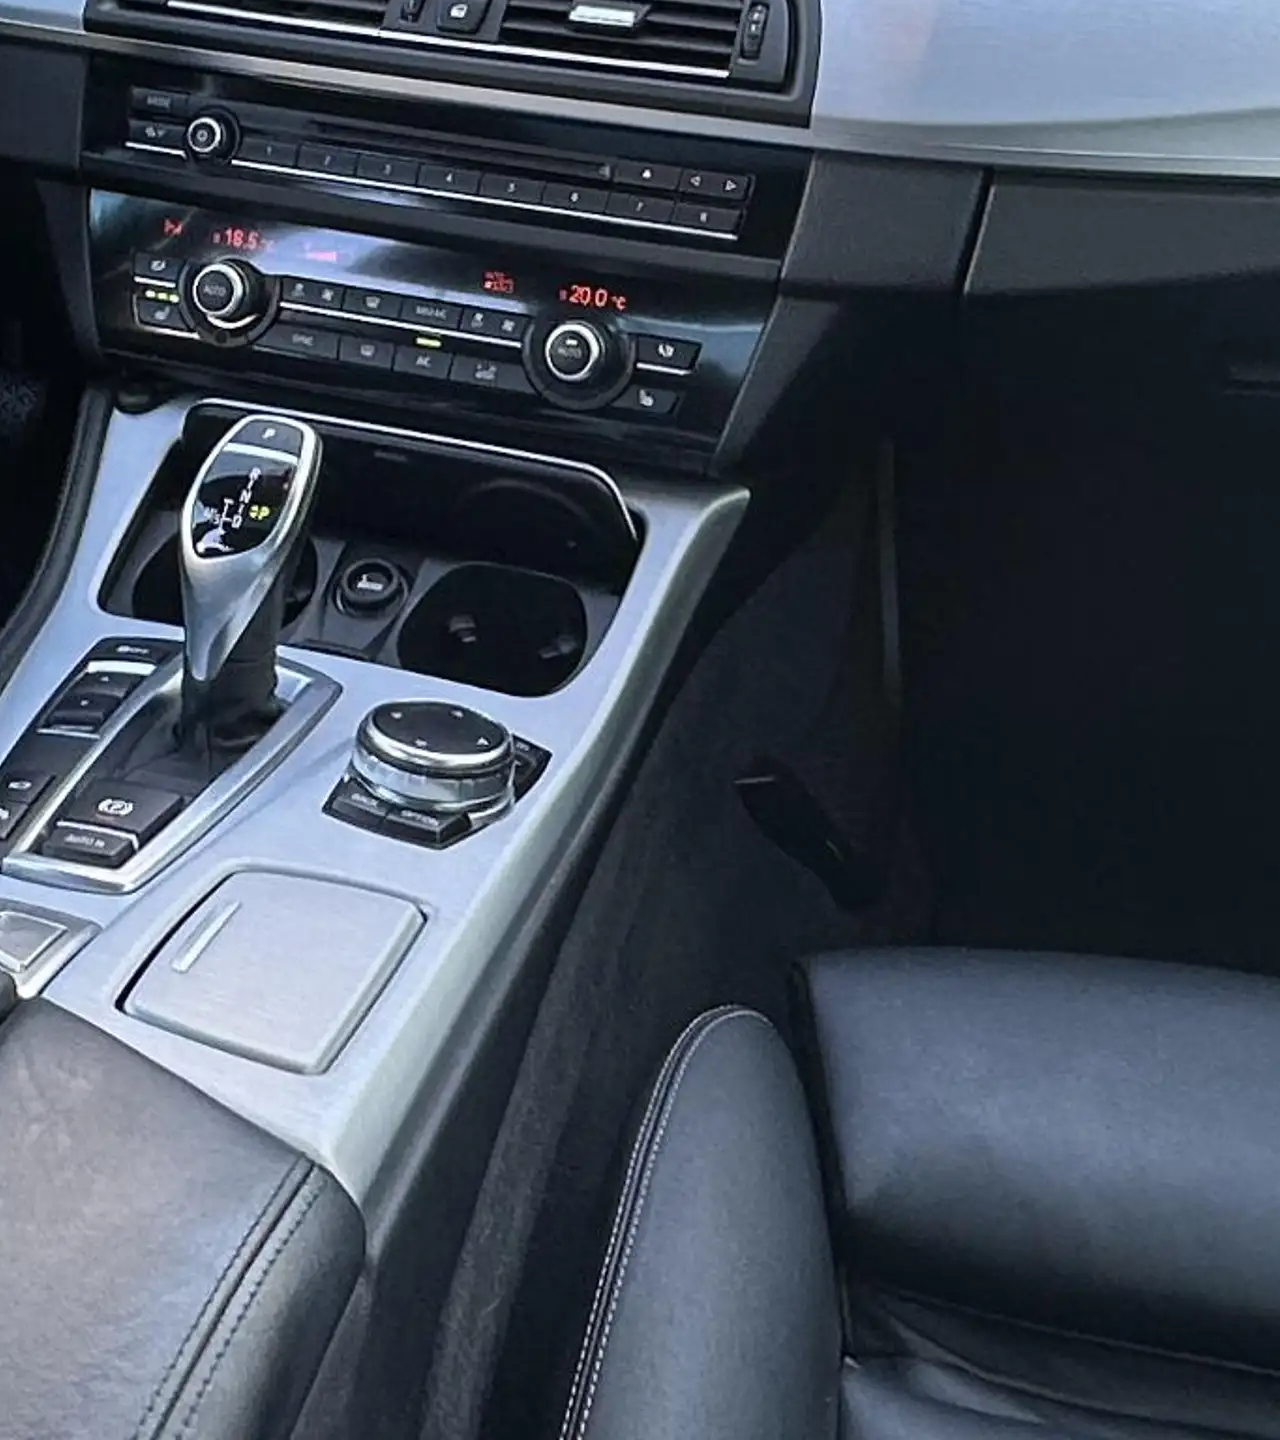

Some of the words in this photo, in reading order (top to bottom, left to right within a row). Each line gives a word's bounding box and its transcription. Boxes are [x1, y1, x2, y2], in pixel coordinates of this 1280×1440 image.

[262, 428, 276, 439] P
[239, 489, 252, 503] N
[231, 514, 242, 529] D
